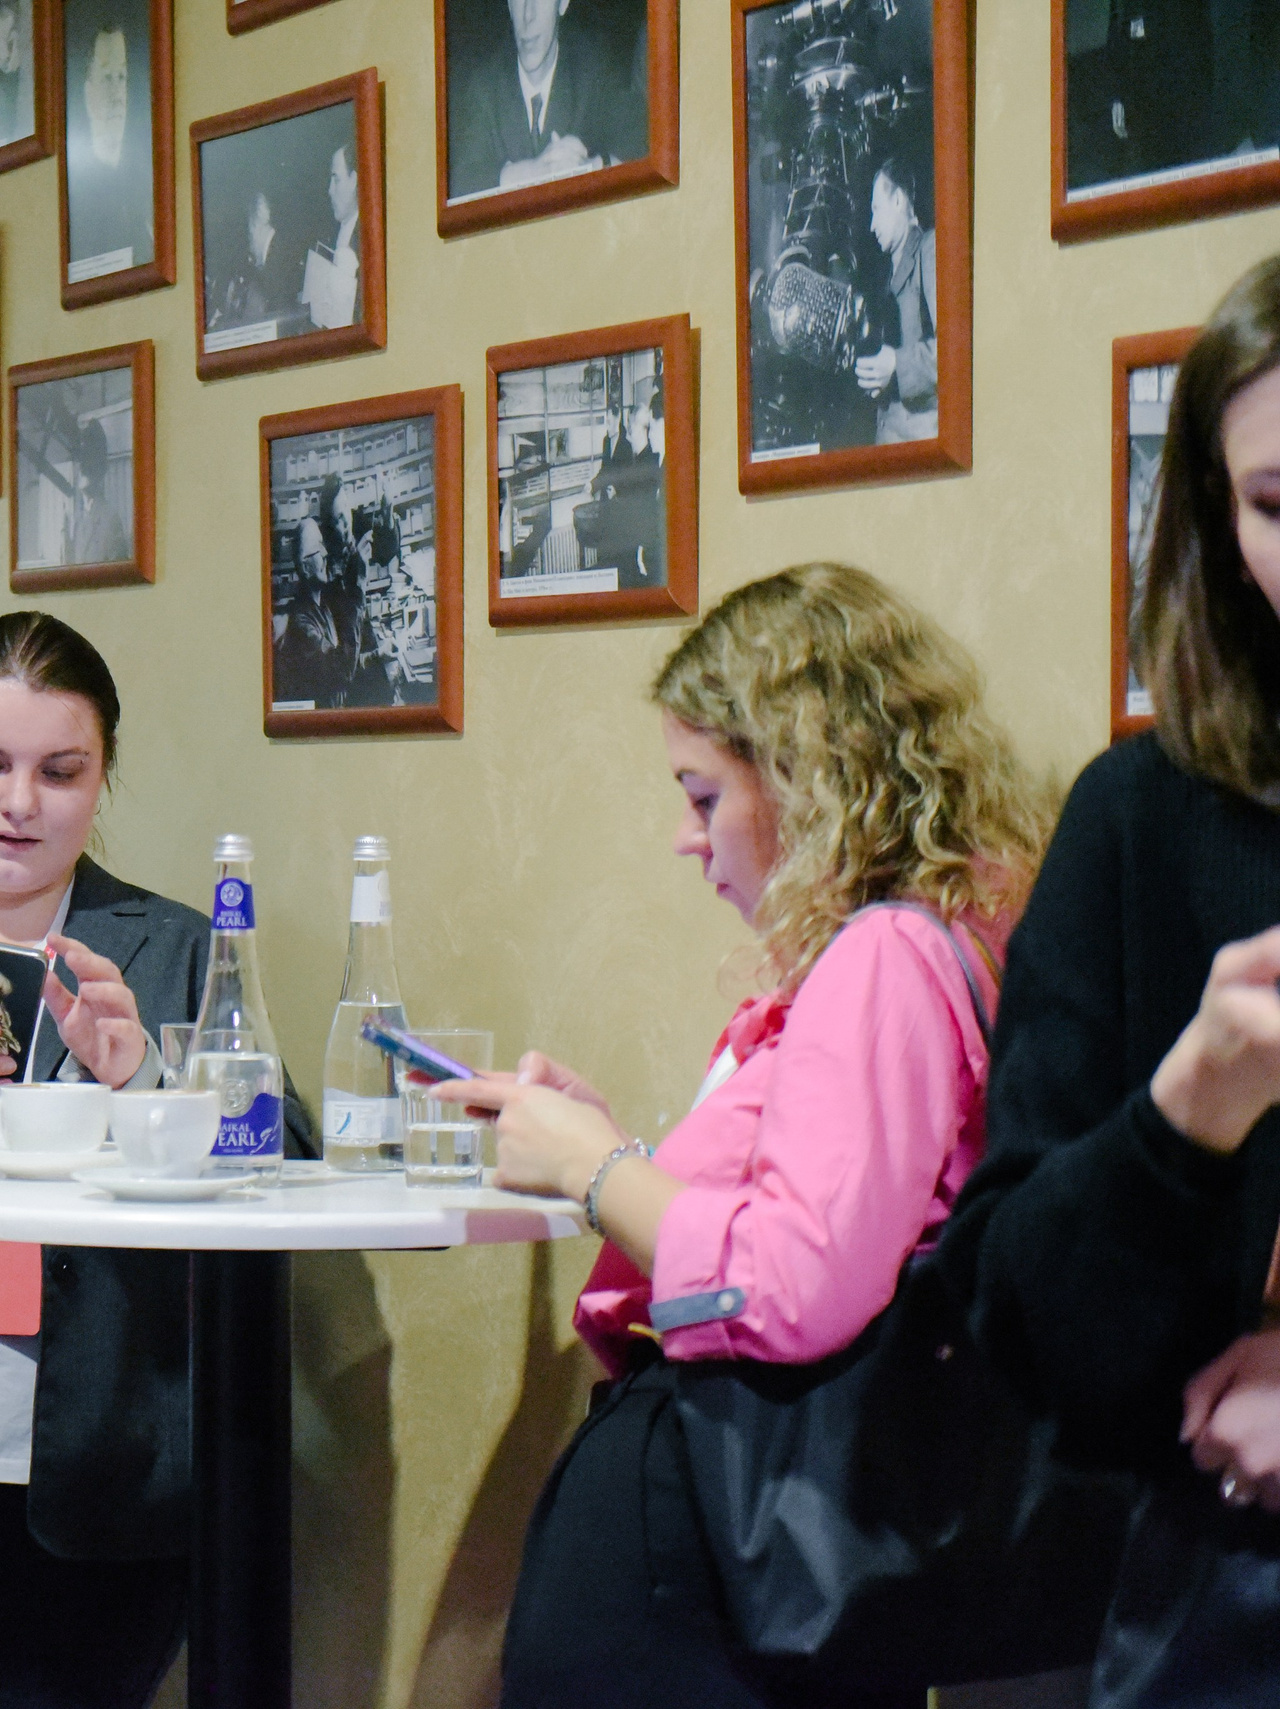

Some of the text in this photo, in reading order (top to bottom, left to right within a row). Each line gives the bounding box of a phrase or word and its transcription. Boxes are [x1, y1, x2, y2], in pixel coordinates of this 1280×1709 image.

[216, 916, 247, 926] PEARL
[220, 1123, 250, 1132] AIKAL
[218, 1132, 258, 1146] EARL
